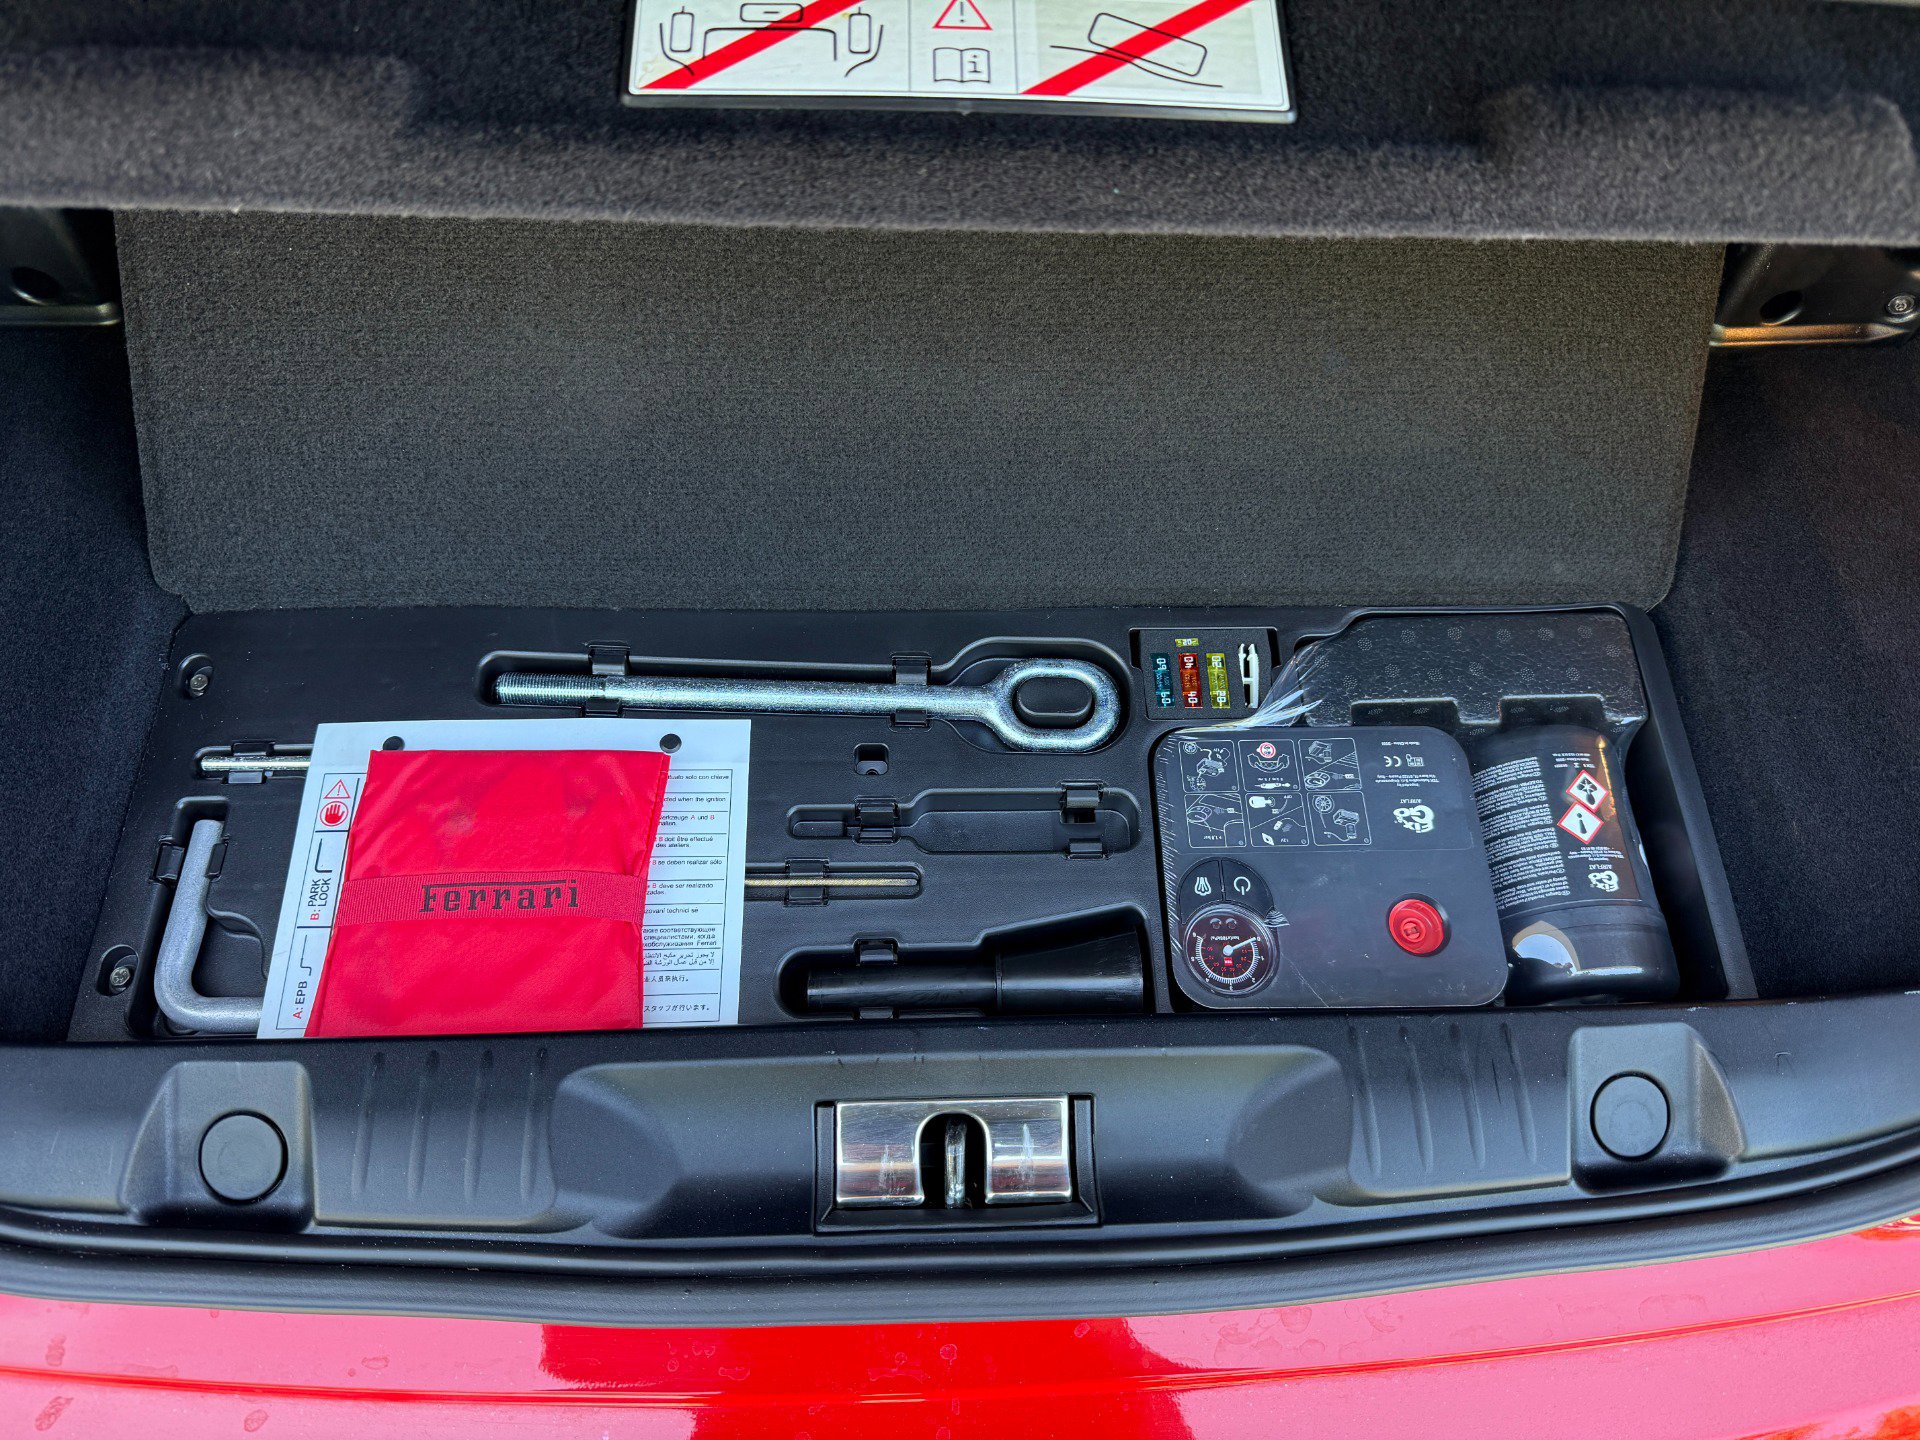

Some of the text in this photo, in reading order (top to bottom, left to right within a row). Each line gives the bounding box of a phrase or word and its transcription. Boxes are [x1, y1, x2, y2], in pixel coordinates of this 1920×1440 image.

[1184, 656, 1194, 669] 40
[1211, 655, 1222, 668] 20
[1188, 691, 1198, 704] 40
[1216, 690, 1226, 703] 20
[1393, 805, 1434, 824] Go
[1403, 821, 1434, 833] Fix
[1587, 870, 1618, 885] Go
[307, 878, 321, 921] B: PARK
[318, 878, 332, 907] LOCK
[419, 879, 579, 913] Ferrari
[292, 980, 308, 1019] A: EPB
[644, 1004, 710, 1012] スタッフが行います。
